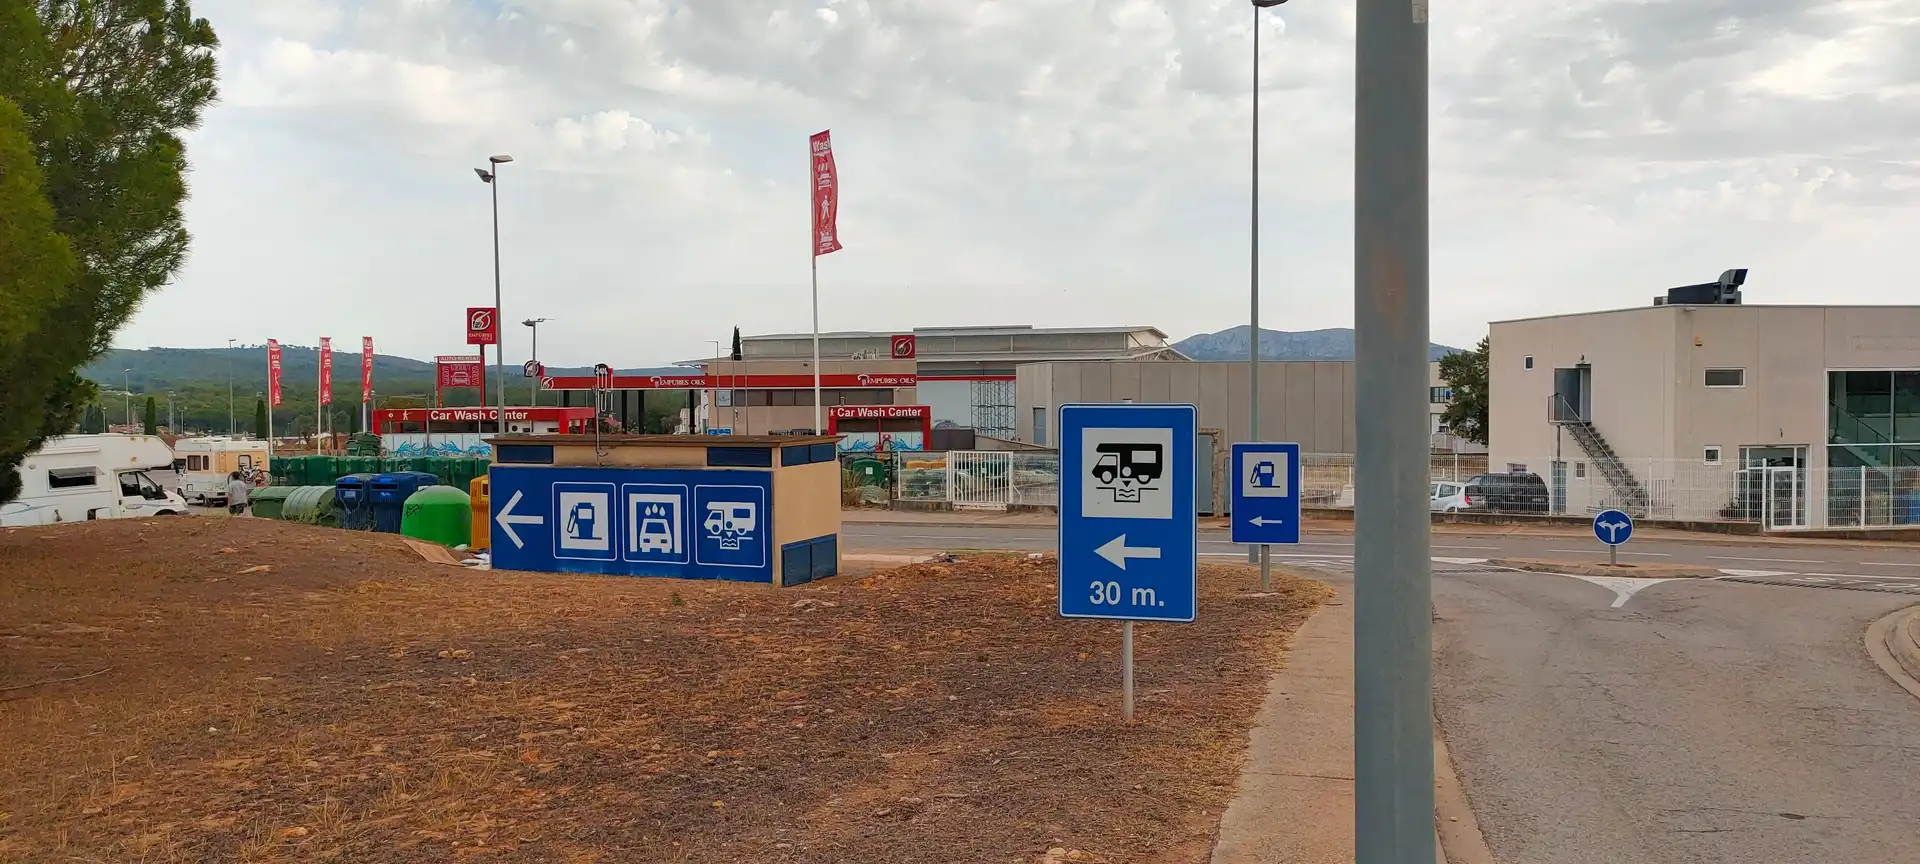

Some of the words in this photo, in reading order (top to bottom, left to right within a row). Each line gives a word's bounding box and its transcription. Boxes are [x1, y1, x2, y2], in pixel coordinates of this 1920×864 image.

[430, 410, 451, 421] Car
[453, 410, 486, 421] Wash
[489, 410, 528, 421] Cnter
[837, 407, 855, 417] Car
[857, 407, 886, 417] Wash
[888, 407, 922, 417] Center
[1089, 580, 1121, 605] 30
[1131, 587, 1165, 607] m.
